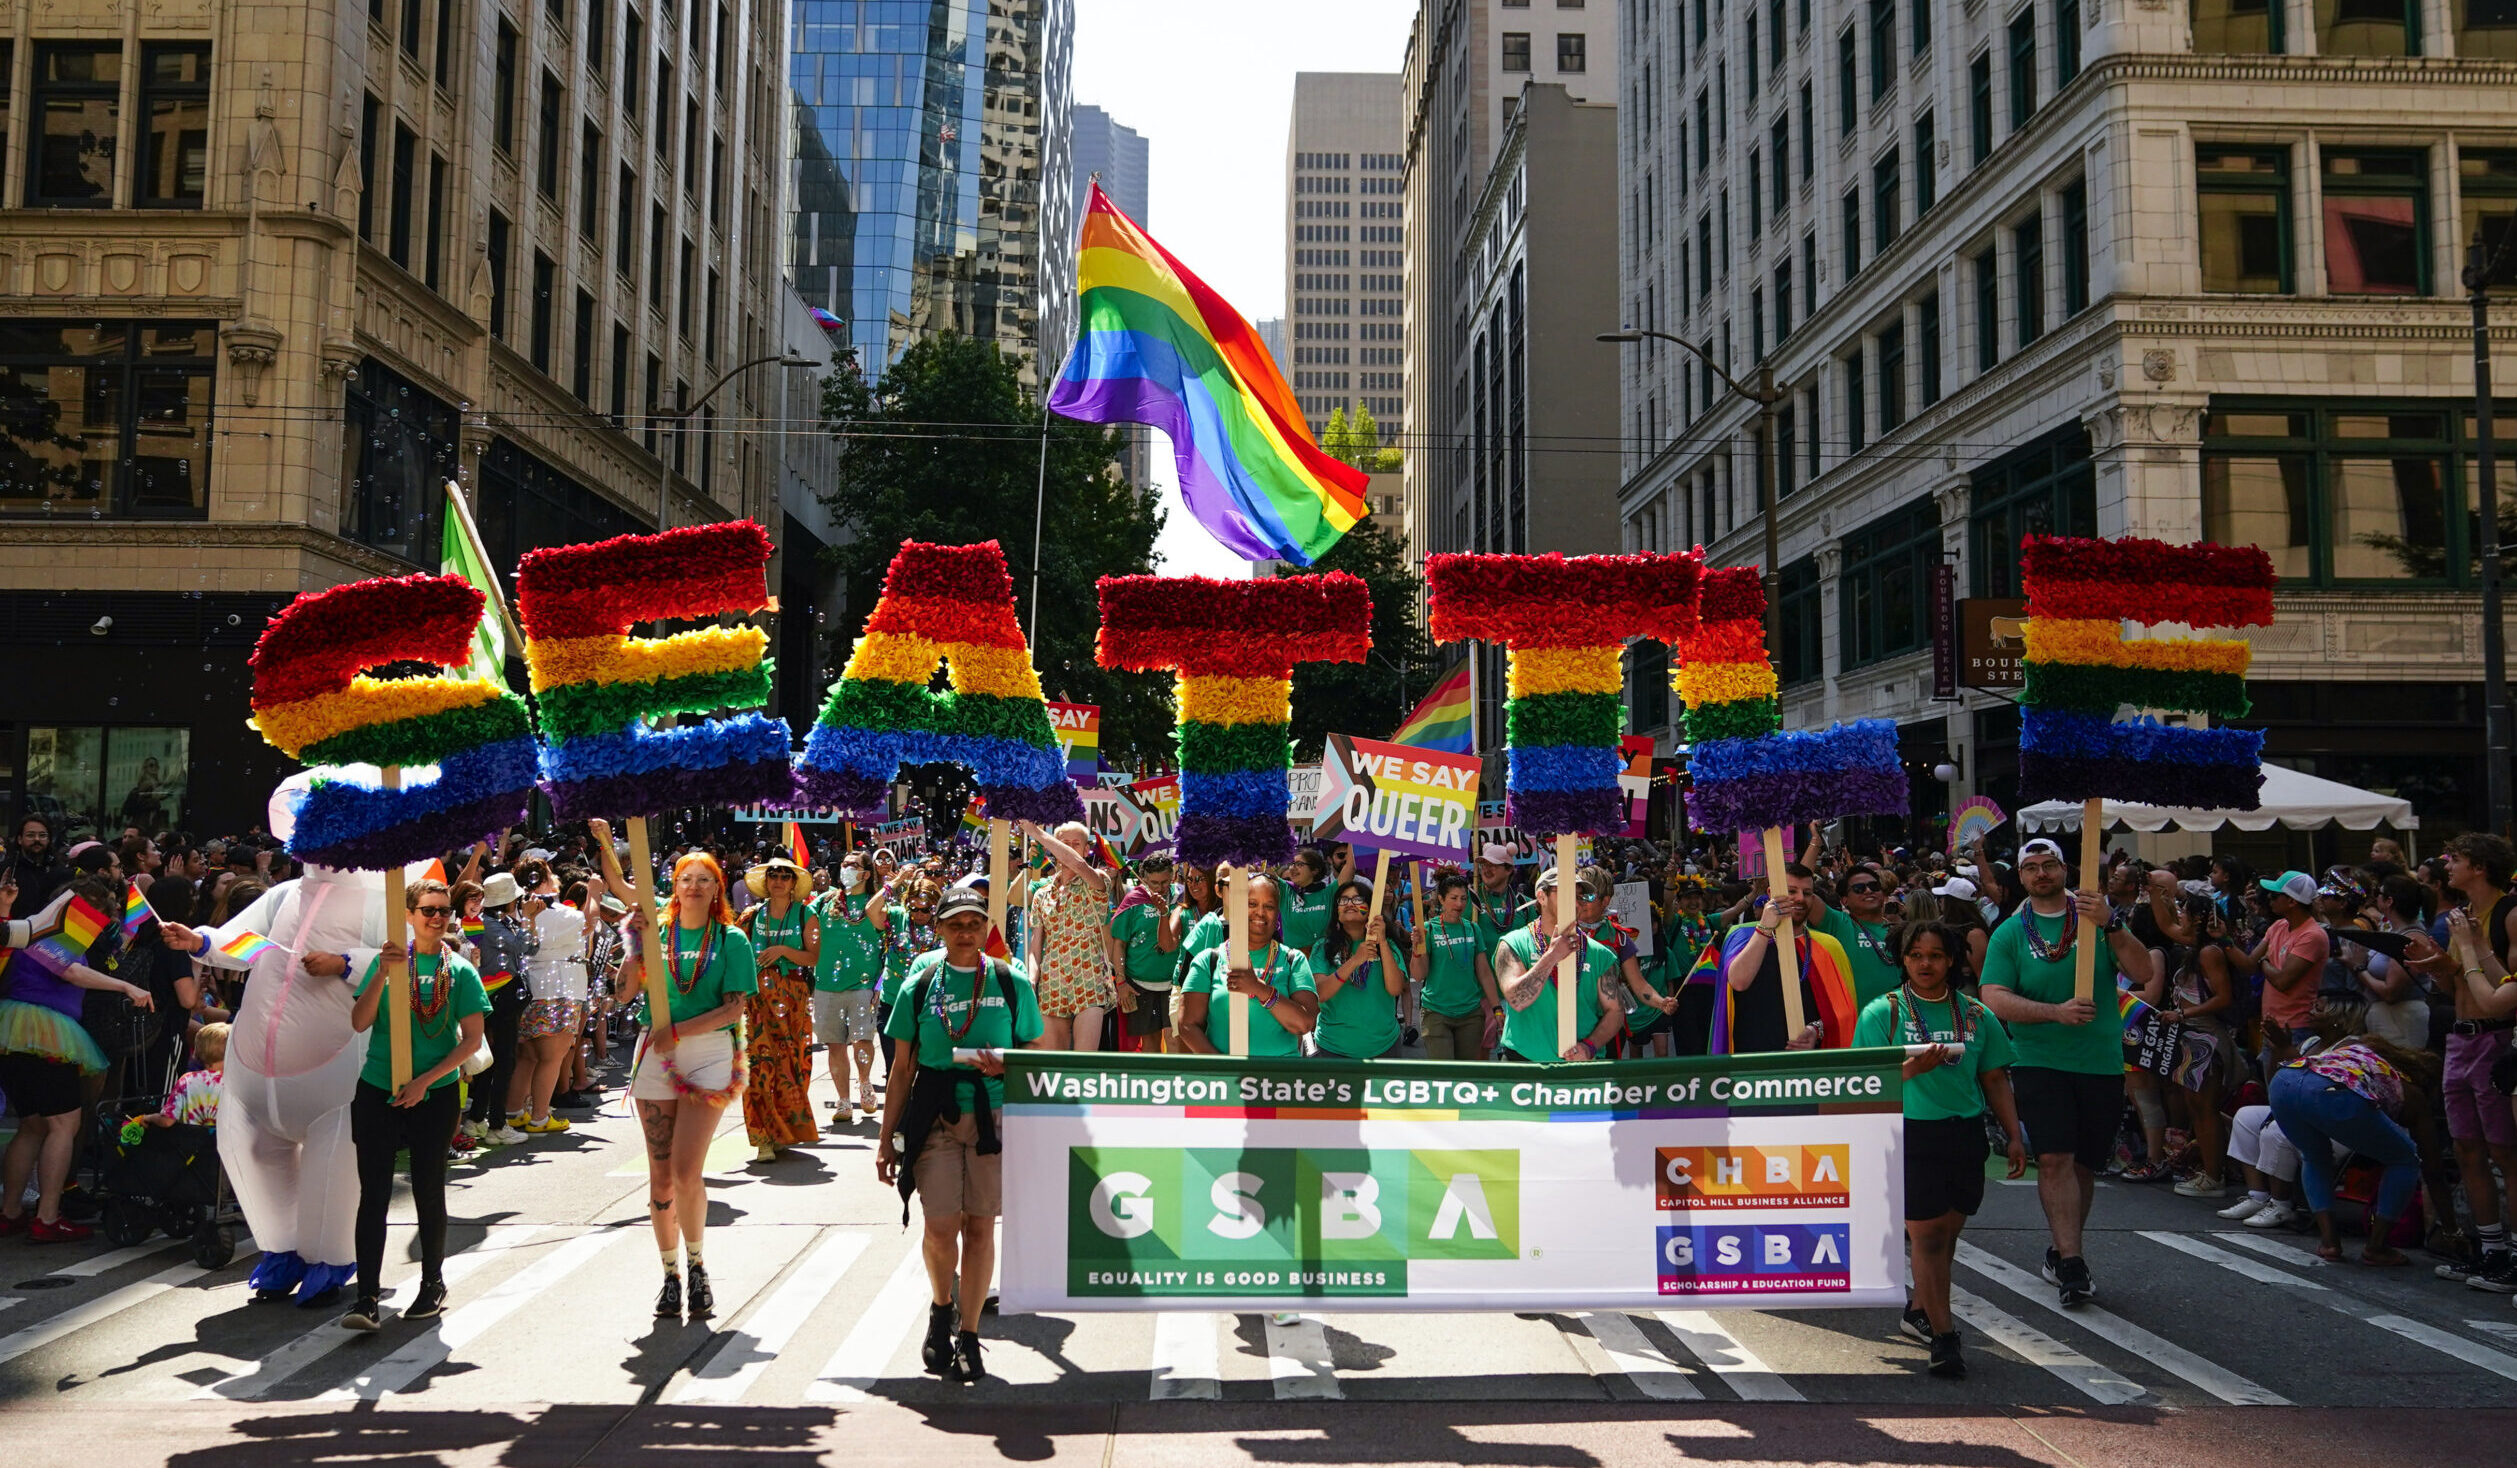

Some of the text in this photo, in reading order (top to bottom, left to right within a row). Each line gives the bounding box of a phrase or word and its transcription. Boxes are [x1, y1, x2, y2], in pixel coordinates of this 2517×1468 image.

[1939, 569, 1950, 683] BOURBON STEAK
[1972, 658, 2024, 668] BOUR
[1987, 671, 2025, 681] STE
[1049, 709, 1091, 729] SAY
[1351, 750, 1475, 791] WE SAY
[1288, 772, 1321, 791] PROT
[1134, 785, 1174, 806] WE
[1140, 808, 1178, 844] QU
[1342, 784, 1466, 850] QUEER
[884, 823, 899, 835] WE
[2139, 1015, 2161, 1069] BE GAY
[2156, 1038, 2164, 1053] AND
[2159, 1023, 2179, 1076] ORGANIZE
[1026, 1072, 1882, 1106] Washington State’s LGBTQ+ Chamber of Commerce
[1089, 1171, 1499, 1240] GSBA
[1660, 1196, 1845, 1207] CAPITOL HILL BUSINESS ALLIANCE
[1088, 1272, 1387, 1286] EQUALITY IS GOOD BUSINESS
[1663, 1279, 1846, 1290] SCHOLARSHIP & EDUCATION FUND
